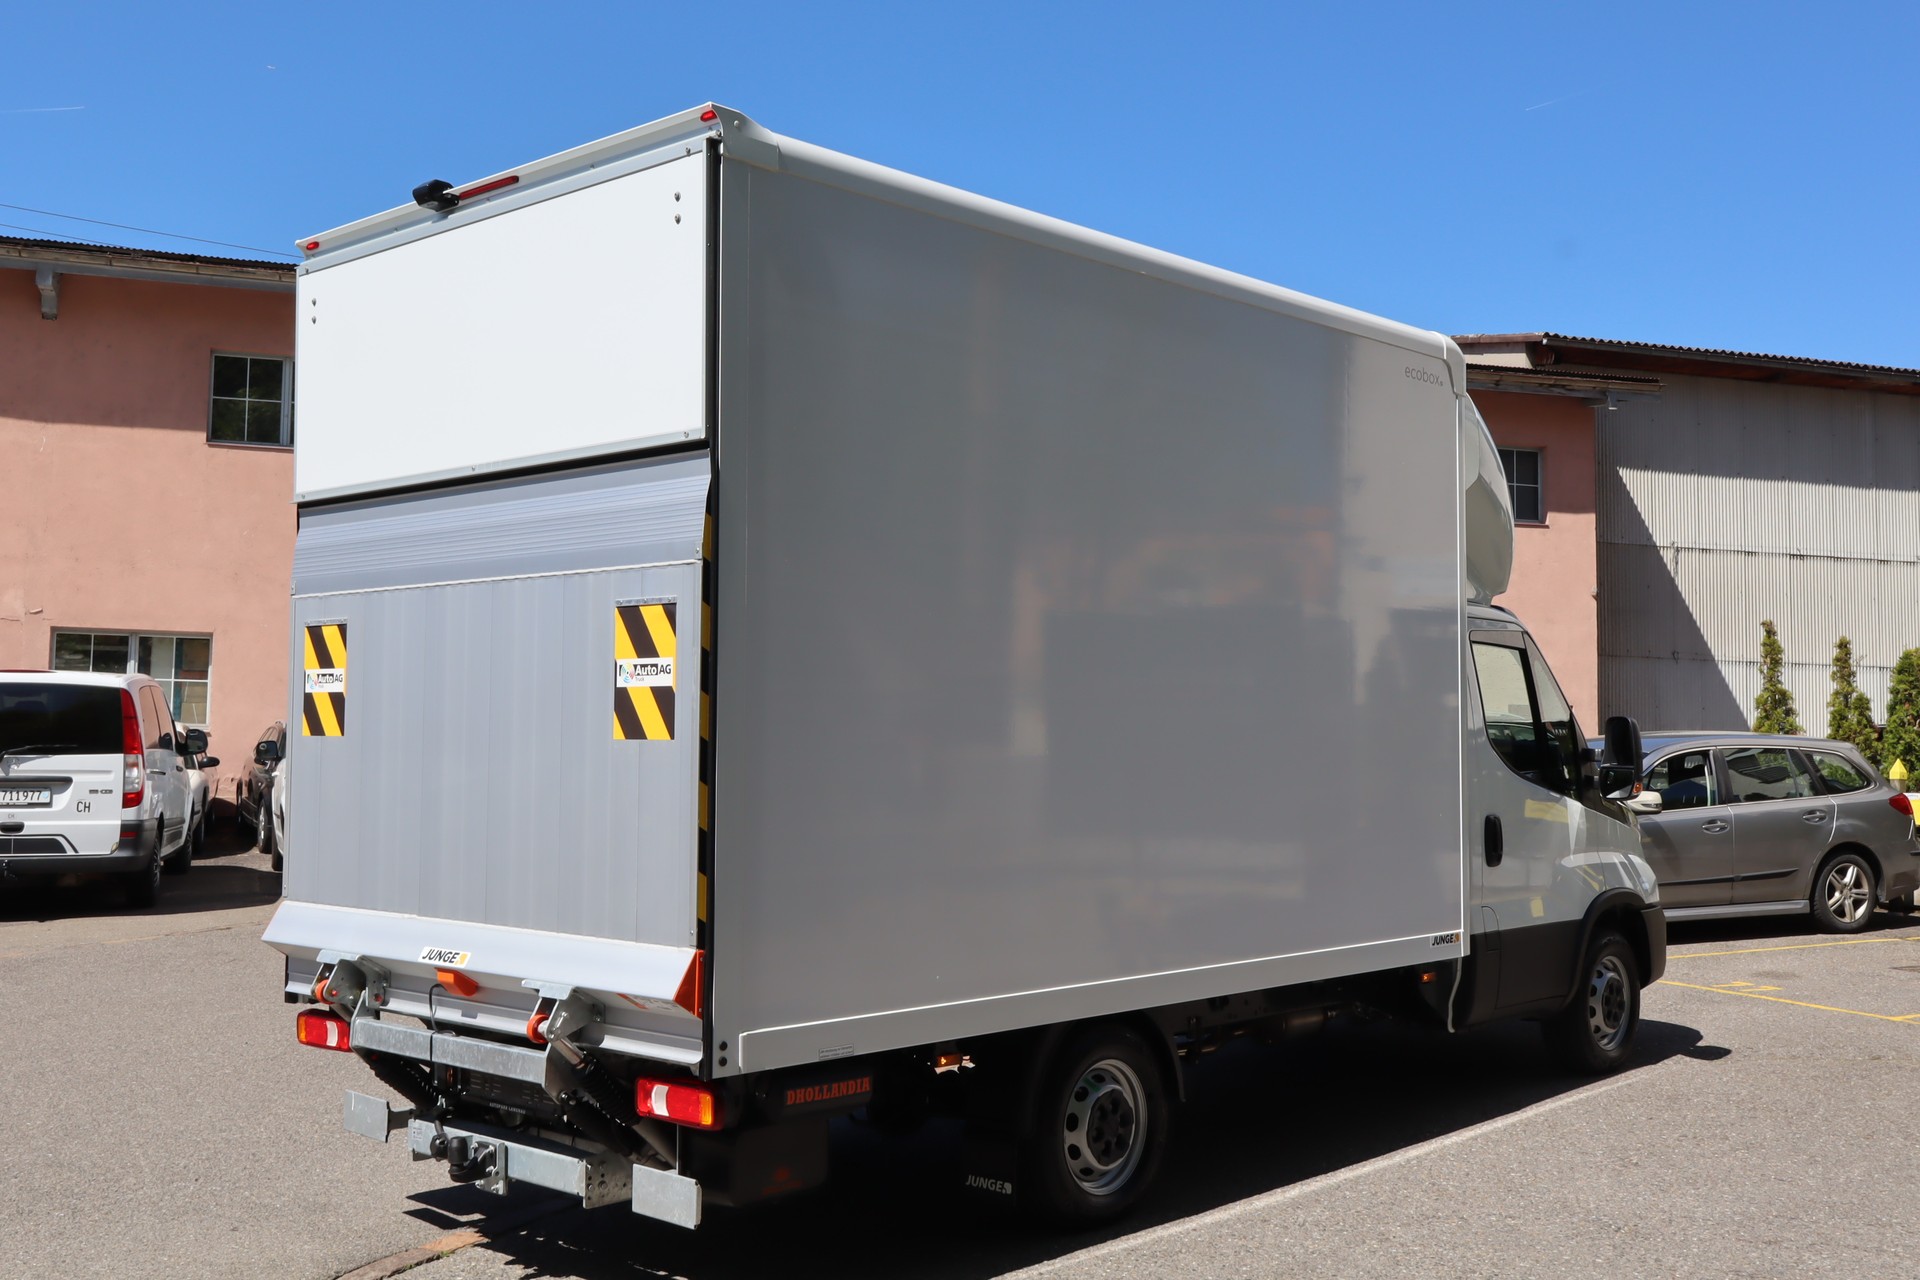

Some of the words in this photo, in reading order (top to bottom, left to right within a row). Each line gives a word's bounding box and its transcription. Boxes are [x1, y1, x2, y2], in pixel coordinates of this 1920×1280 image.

[1404, 366, 1440, 386] ecobox
[635, 664, 657, 676] Auto
[659, 664, 671, 675] AG
[319, 674, 334, 683] Auto
[335, 673, 343, 683] AG
[2, 790, 42, 801] 711977
[76, 801, 91, 813] CH
[1432, 934, 1454, 946] JUNGE
[422, 948, 460, 964] JUNGE
[786, 1076, 871, 1105] DHOLLANDIA
[965, 1174, 1003, 1192] JUNGE
